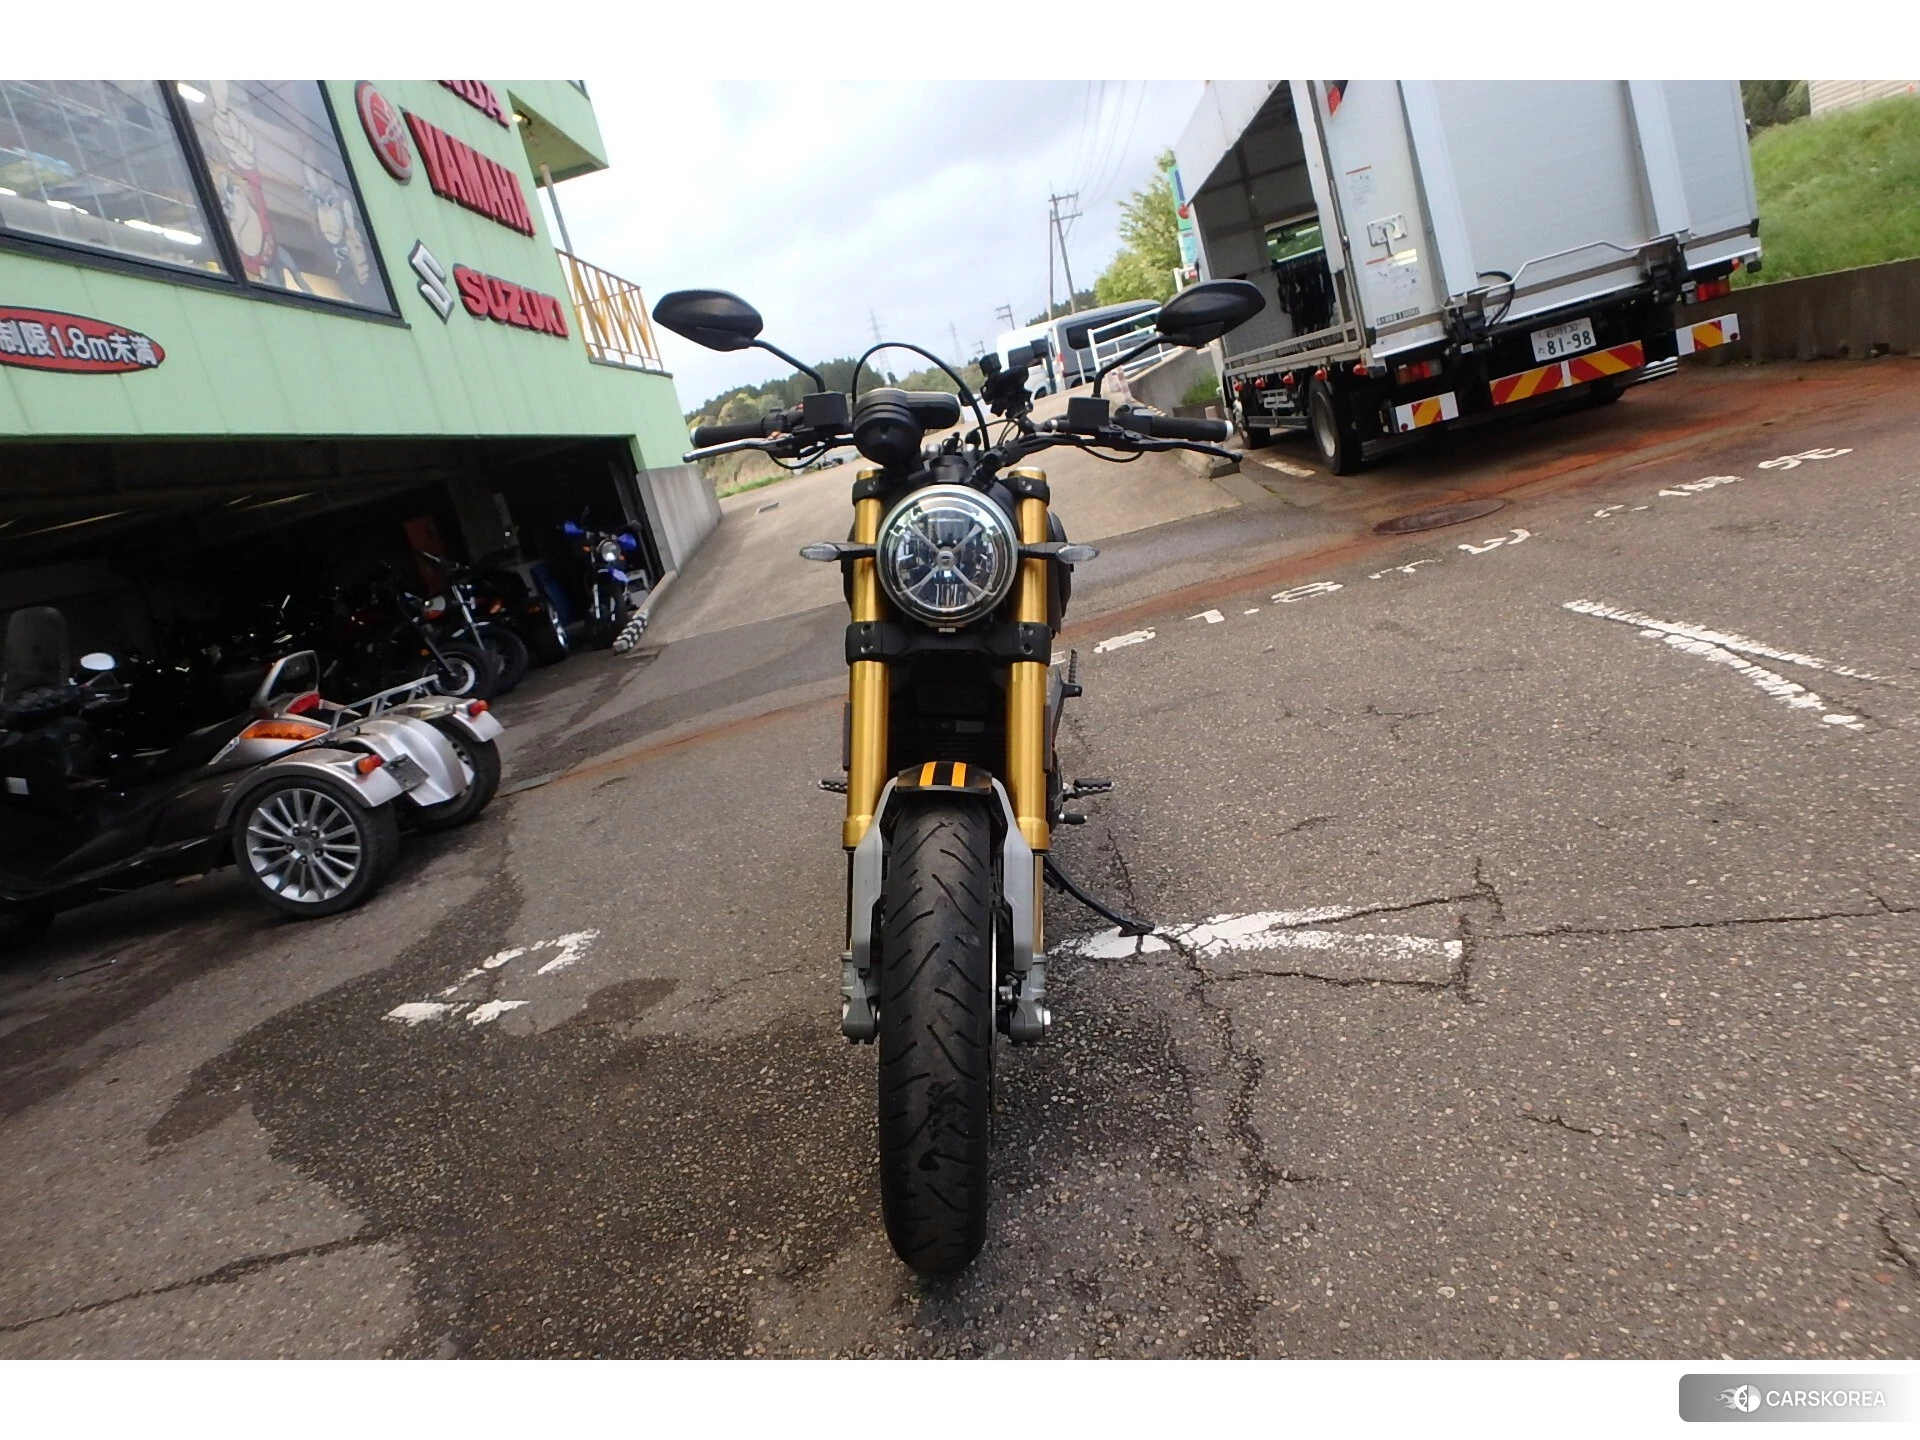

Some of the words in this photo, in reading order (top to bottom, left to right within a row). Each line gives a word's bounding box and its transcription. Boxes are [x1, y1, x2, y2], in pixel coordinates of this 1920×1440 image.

[401, 110, 536, 237] YAMAHA
[453, 263, 569, 339] SUZUKI
[1547, 330, 1592, 355] 81-98
